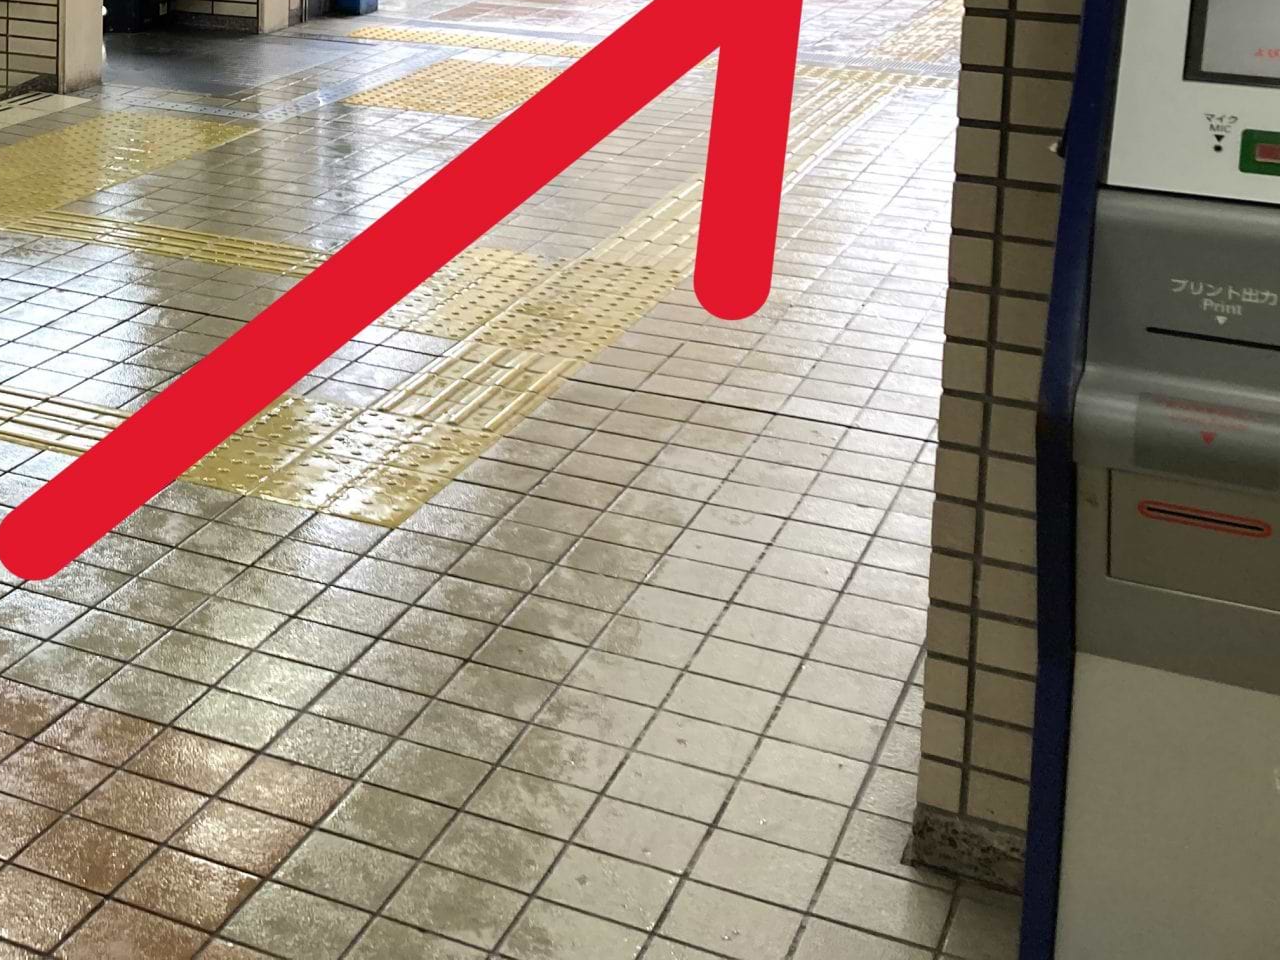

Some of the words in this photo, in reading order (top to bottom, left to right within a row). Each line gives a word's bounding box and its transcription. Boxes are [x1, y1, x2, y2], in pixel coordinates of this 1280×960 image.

[1204, 113, 1239, 124] マイク
[1209, 123, 1232, 134] MIC
[1171, 278, 1279, 306] プリント出力
[1203, 298, 1242, 316] Print
